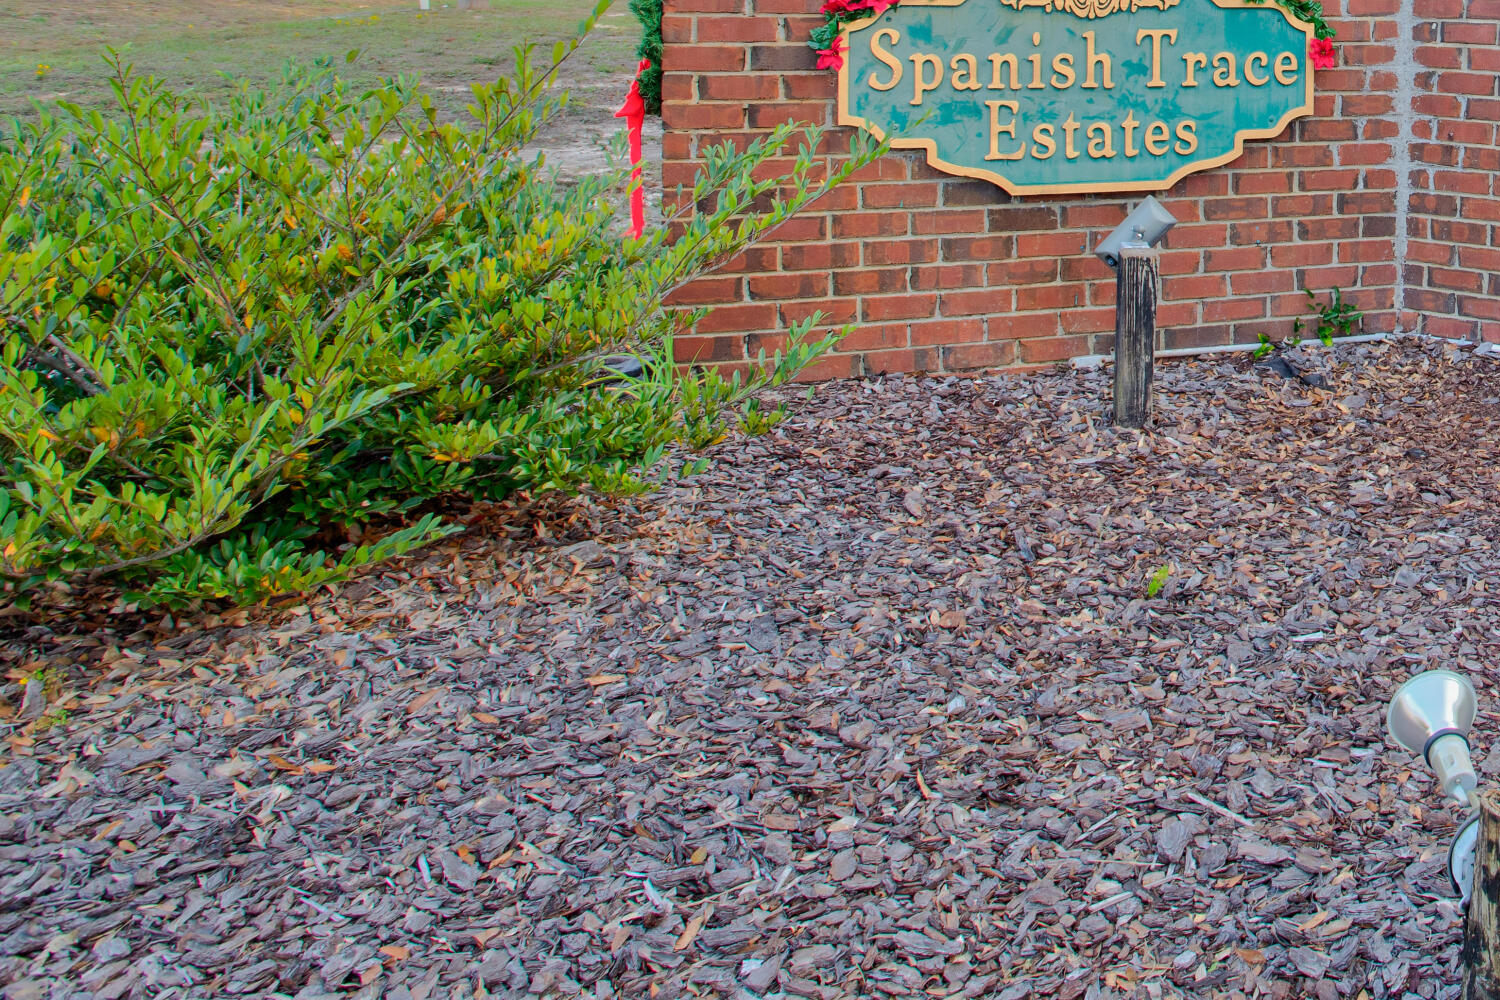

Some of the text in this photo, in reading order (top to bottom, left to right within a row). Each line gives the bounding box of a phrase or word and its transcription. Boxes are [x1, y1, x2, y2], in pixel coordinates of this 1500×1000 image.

[868, 28, 1299, 105] Spanish Trace
[984, 100, 1199, 161] Estates
